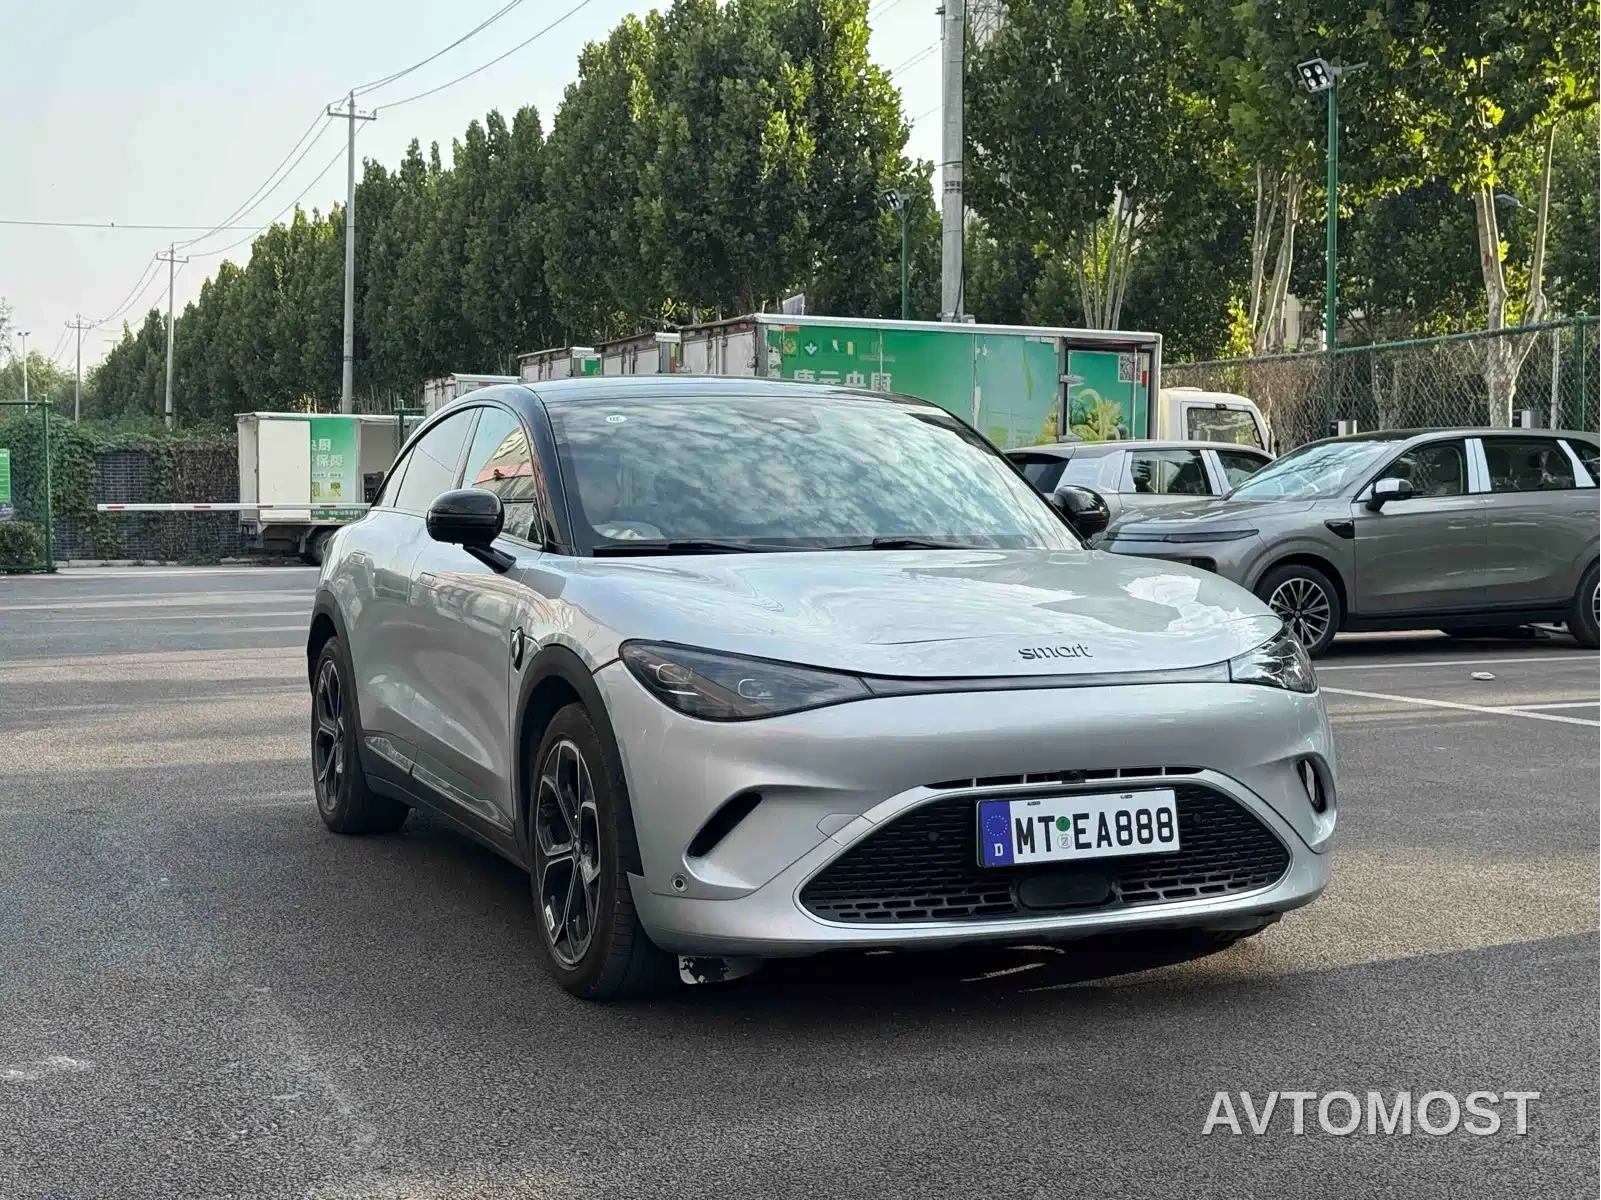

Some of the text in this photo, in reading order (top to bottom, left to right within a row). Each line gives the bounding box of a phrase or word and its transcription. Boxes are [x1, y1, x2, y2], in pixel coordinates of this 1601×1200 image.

[312, 454, 344, 468] 保障
[1018, 643, 1093, 659] smart
[1015, 807, 1175, 855] MT EA888
[994, 843, 1004, 857] D
